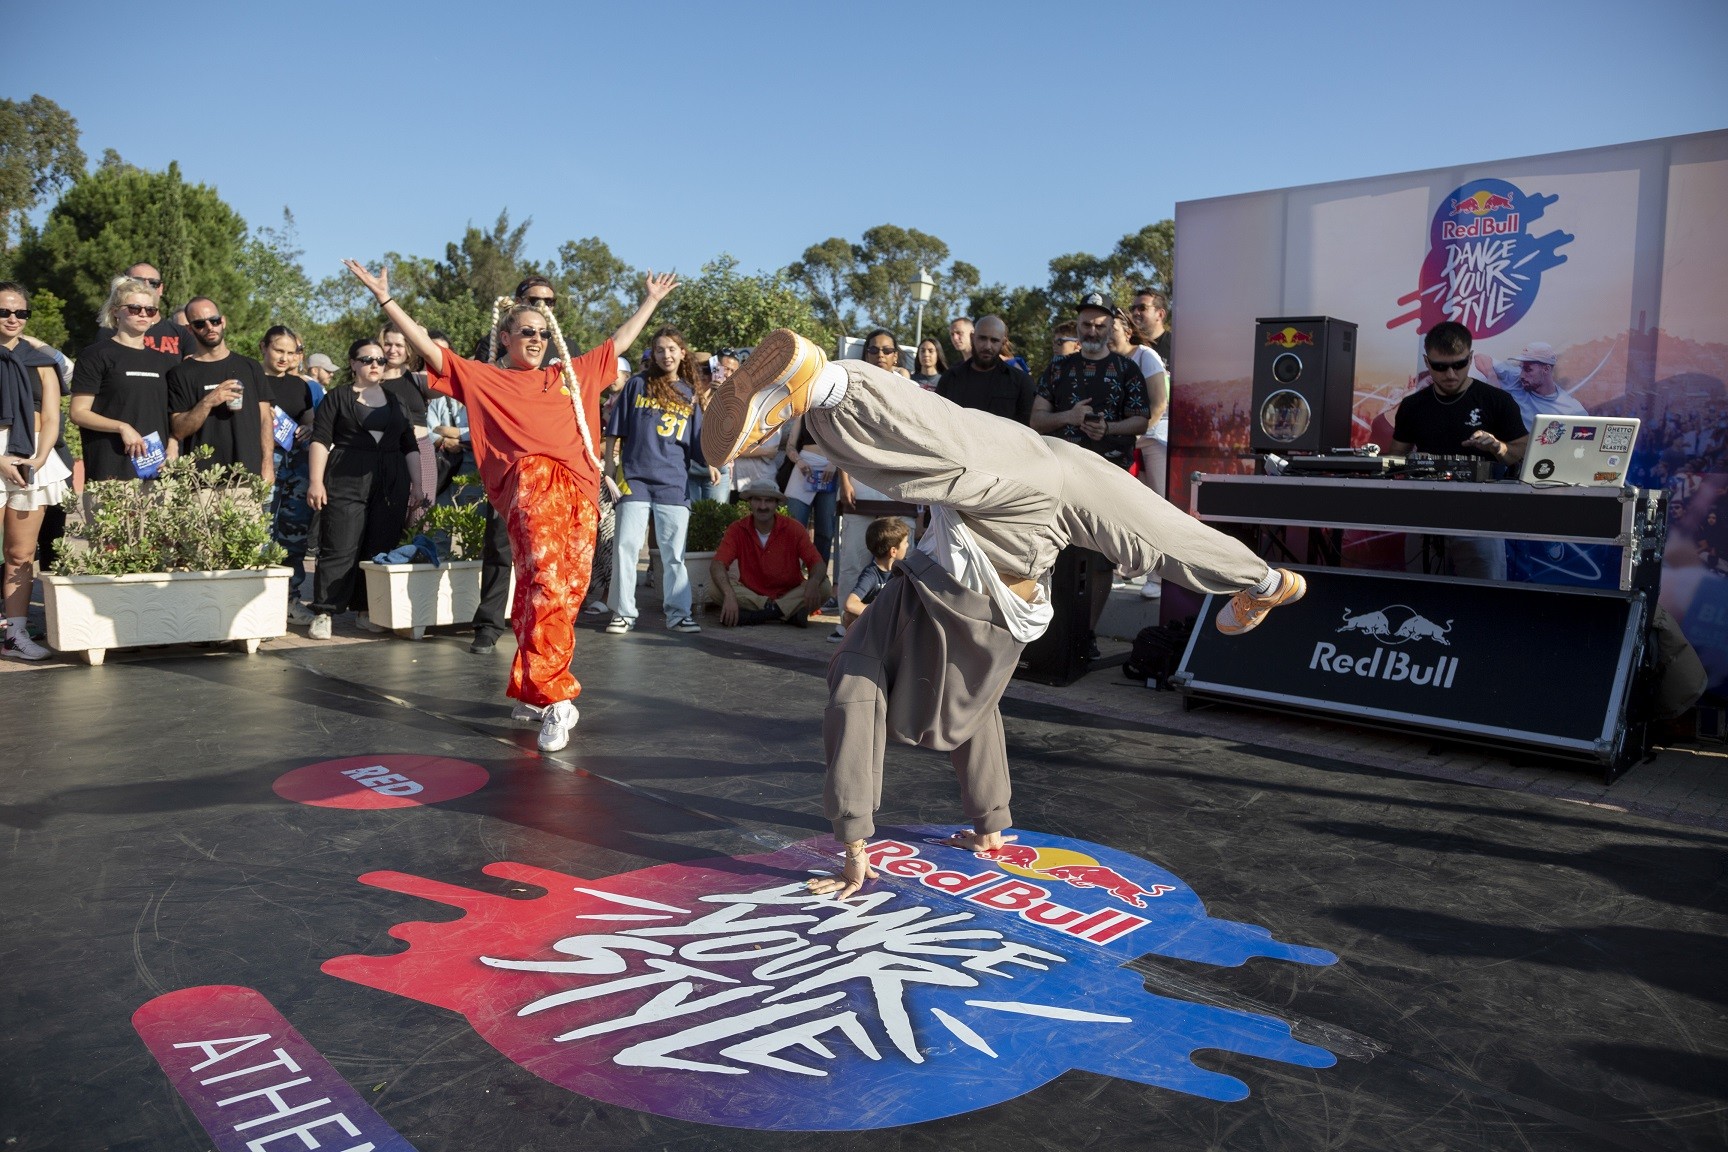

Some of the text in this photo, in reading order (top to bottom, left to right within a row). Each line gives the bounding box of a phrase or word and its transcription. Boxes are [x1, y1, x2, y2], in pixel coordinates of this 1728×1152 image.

[1443, 212, 1519, 240] Red Bull
[1440, 238, 1517, 277] DANCE
[1446, 260, 1522, 301] YOUR
[1442, 282, 1517, 332] STYLE
[656, 413, 688, 441] 31
[1309, 641, 1459, 688] Red Bull
[340, 765, 424, 796] RED
[840, 839, 1152, 946] Red Bull
[480, 934, 882, 1077] STYLE
[172, 1033, 376, 1152] ATHE
